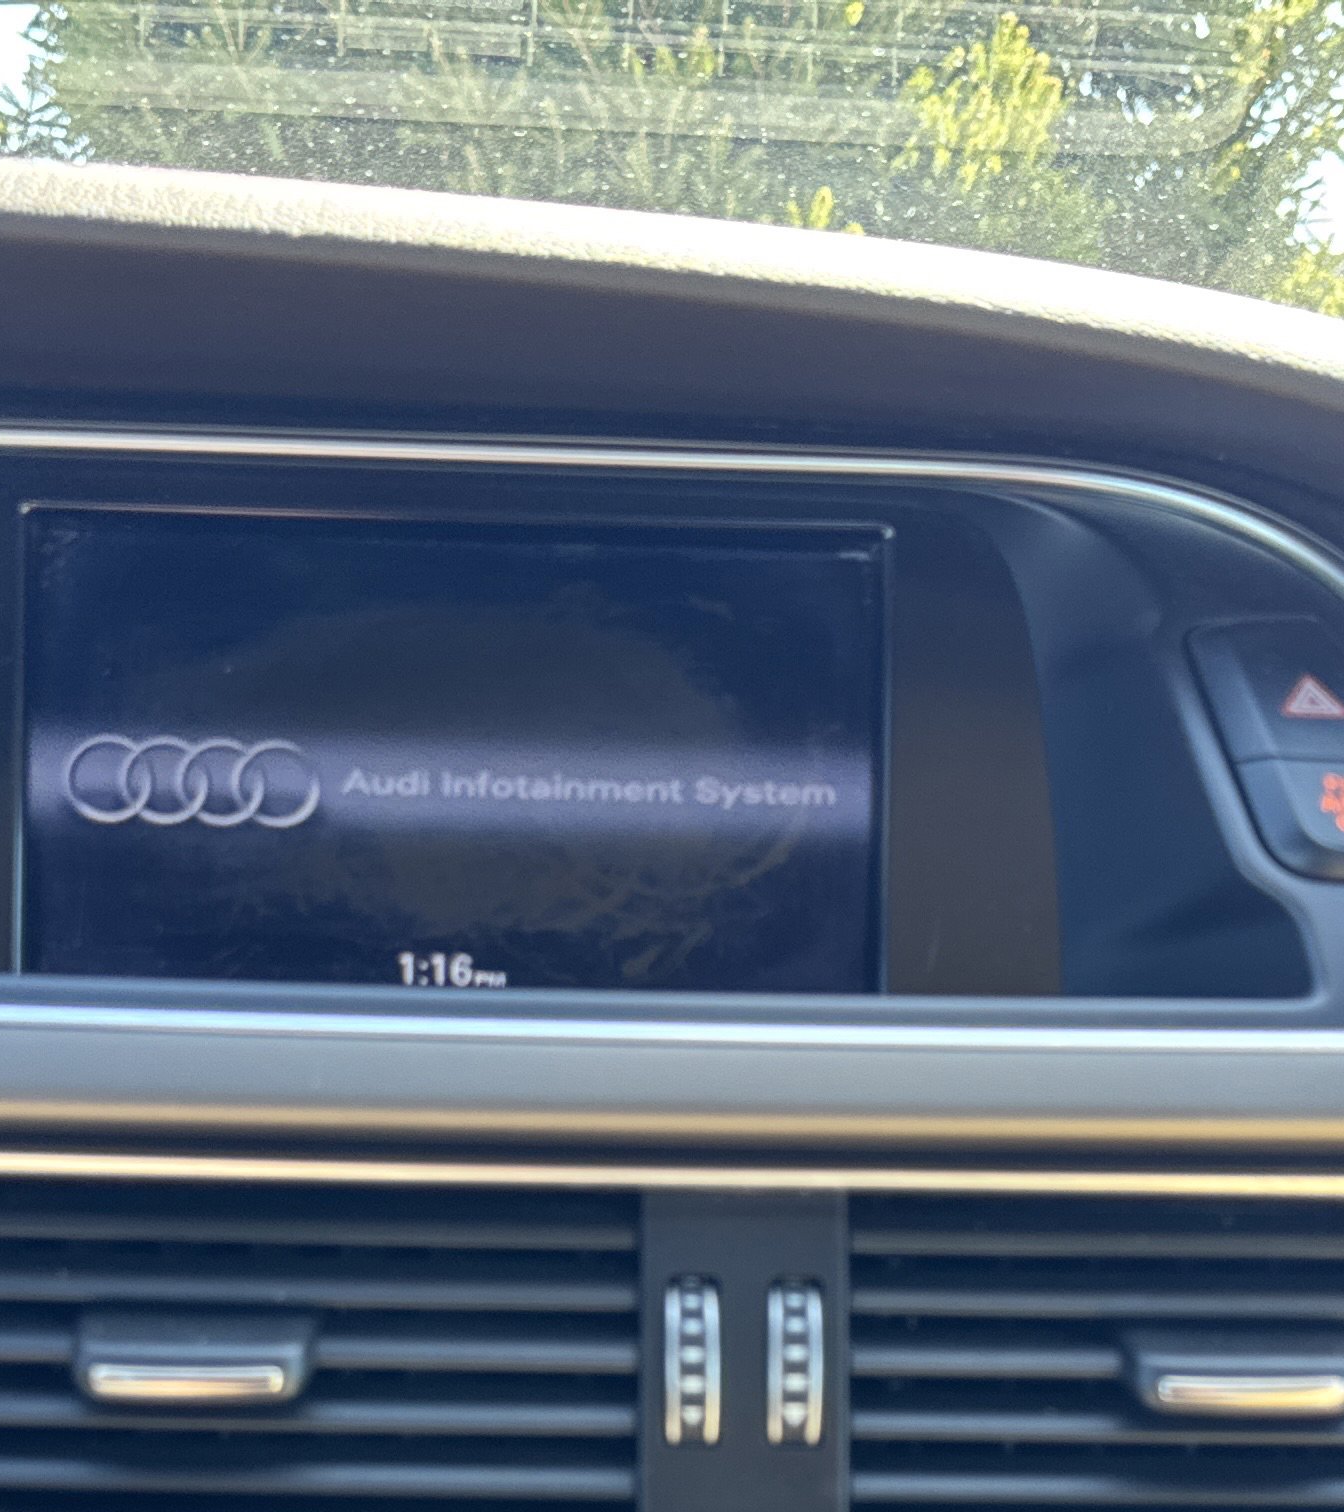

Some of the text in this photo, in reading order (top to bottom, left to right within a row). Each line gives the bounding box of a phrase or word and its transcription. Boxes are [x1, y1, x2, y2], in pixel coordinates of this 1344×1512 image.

[341, 769, 838, 812] Audi Infotainment System
